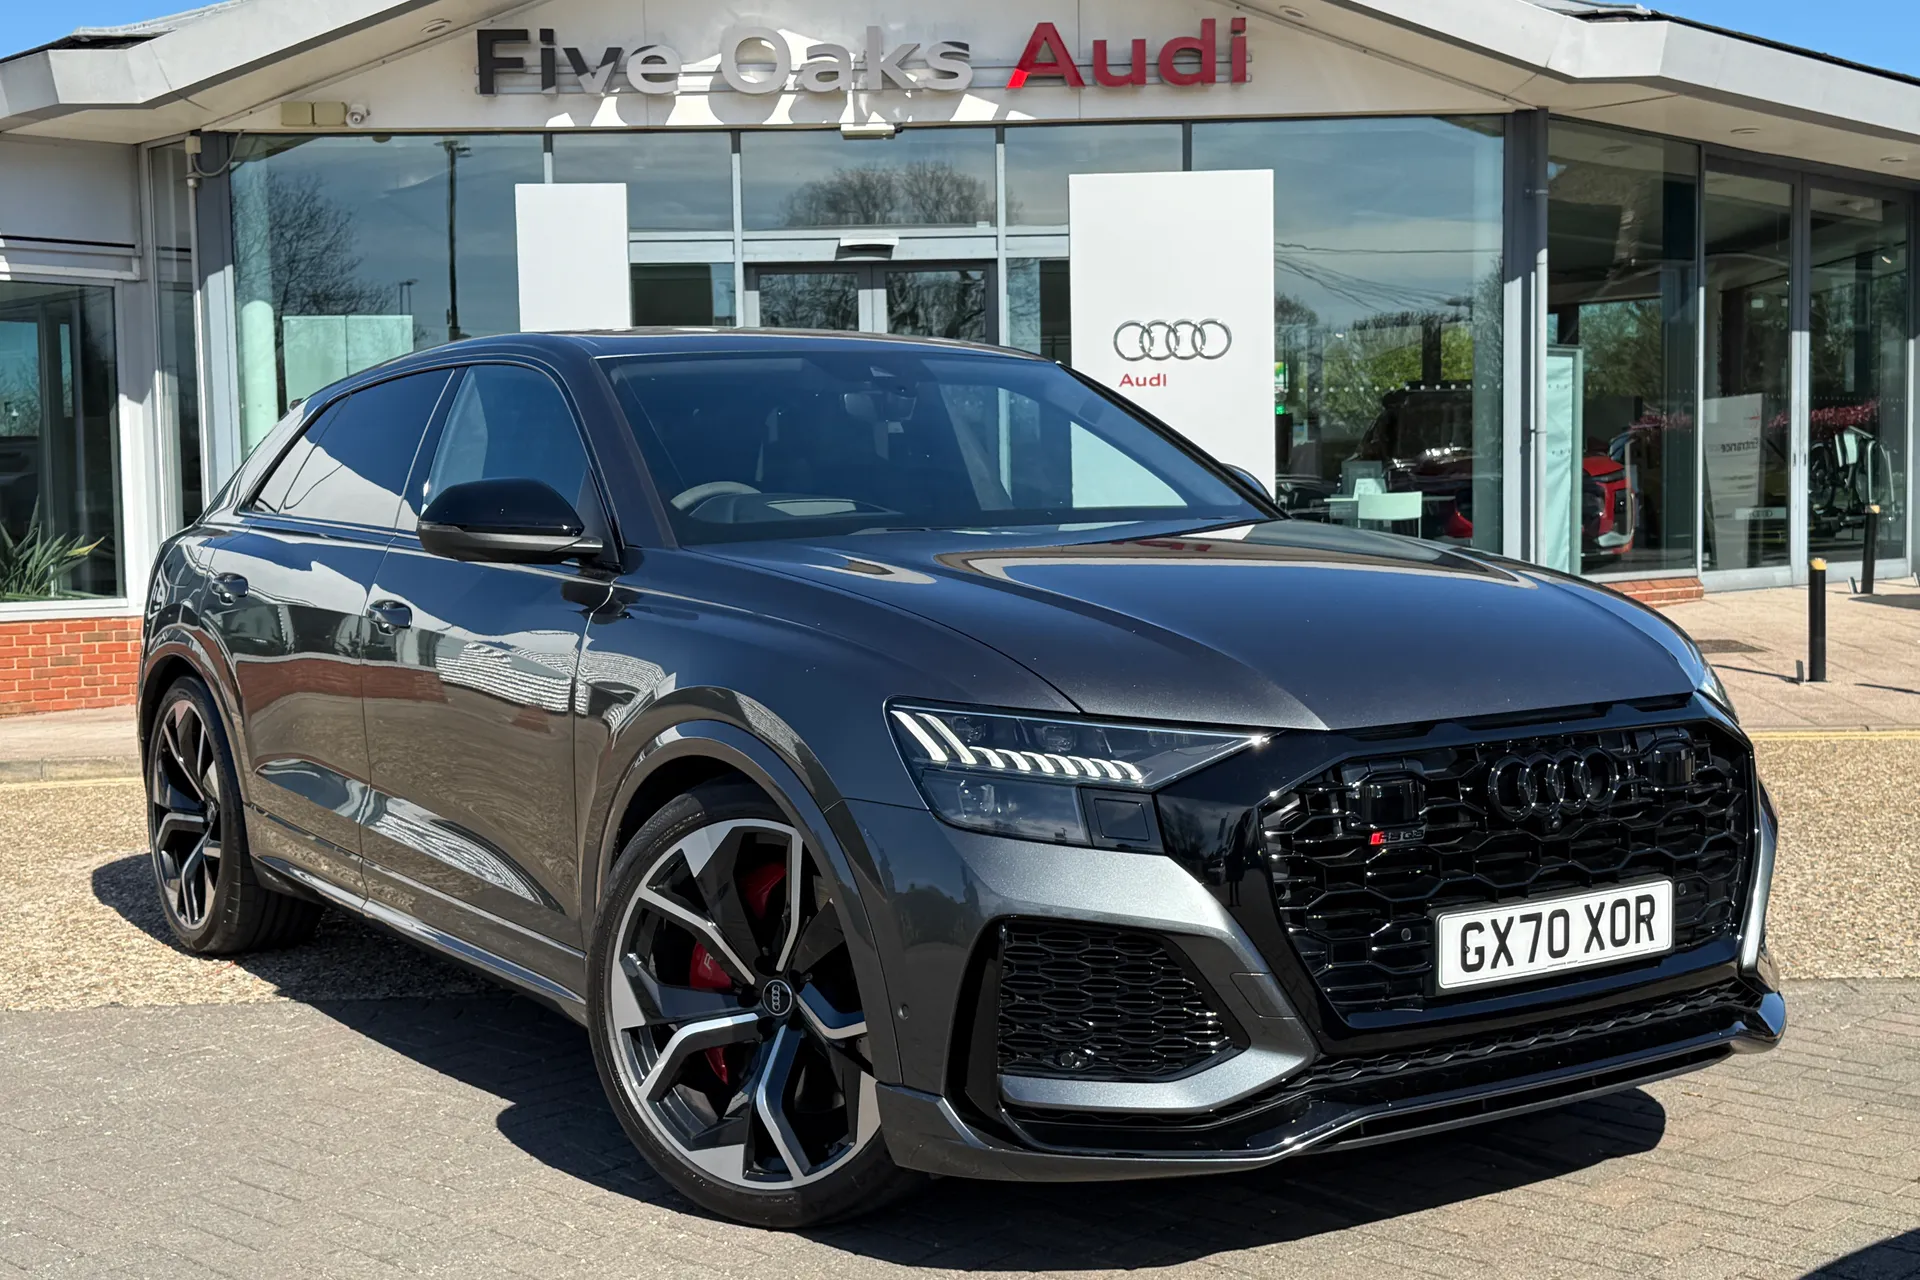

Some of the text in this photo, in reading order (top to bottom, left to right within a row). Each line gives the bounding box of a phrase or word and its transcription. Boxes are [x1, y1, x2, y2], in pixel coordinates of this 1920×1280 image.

[477, 17, 1247, 96] Five Oaks Audi
[1119, 373, 1167, 387] Audi
[1460, 893, 1656, 973] GX70 XOR
